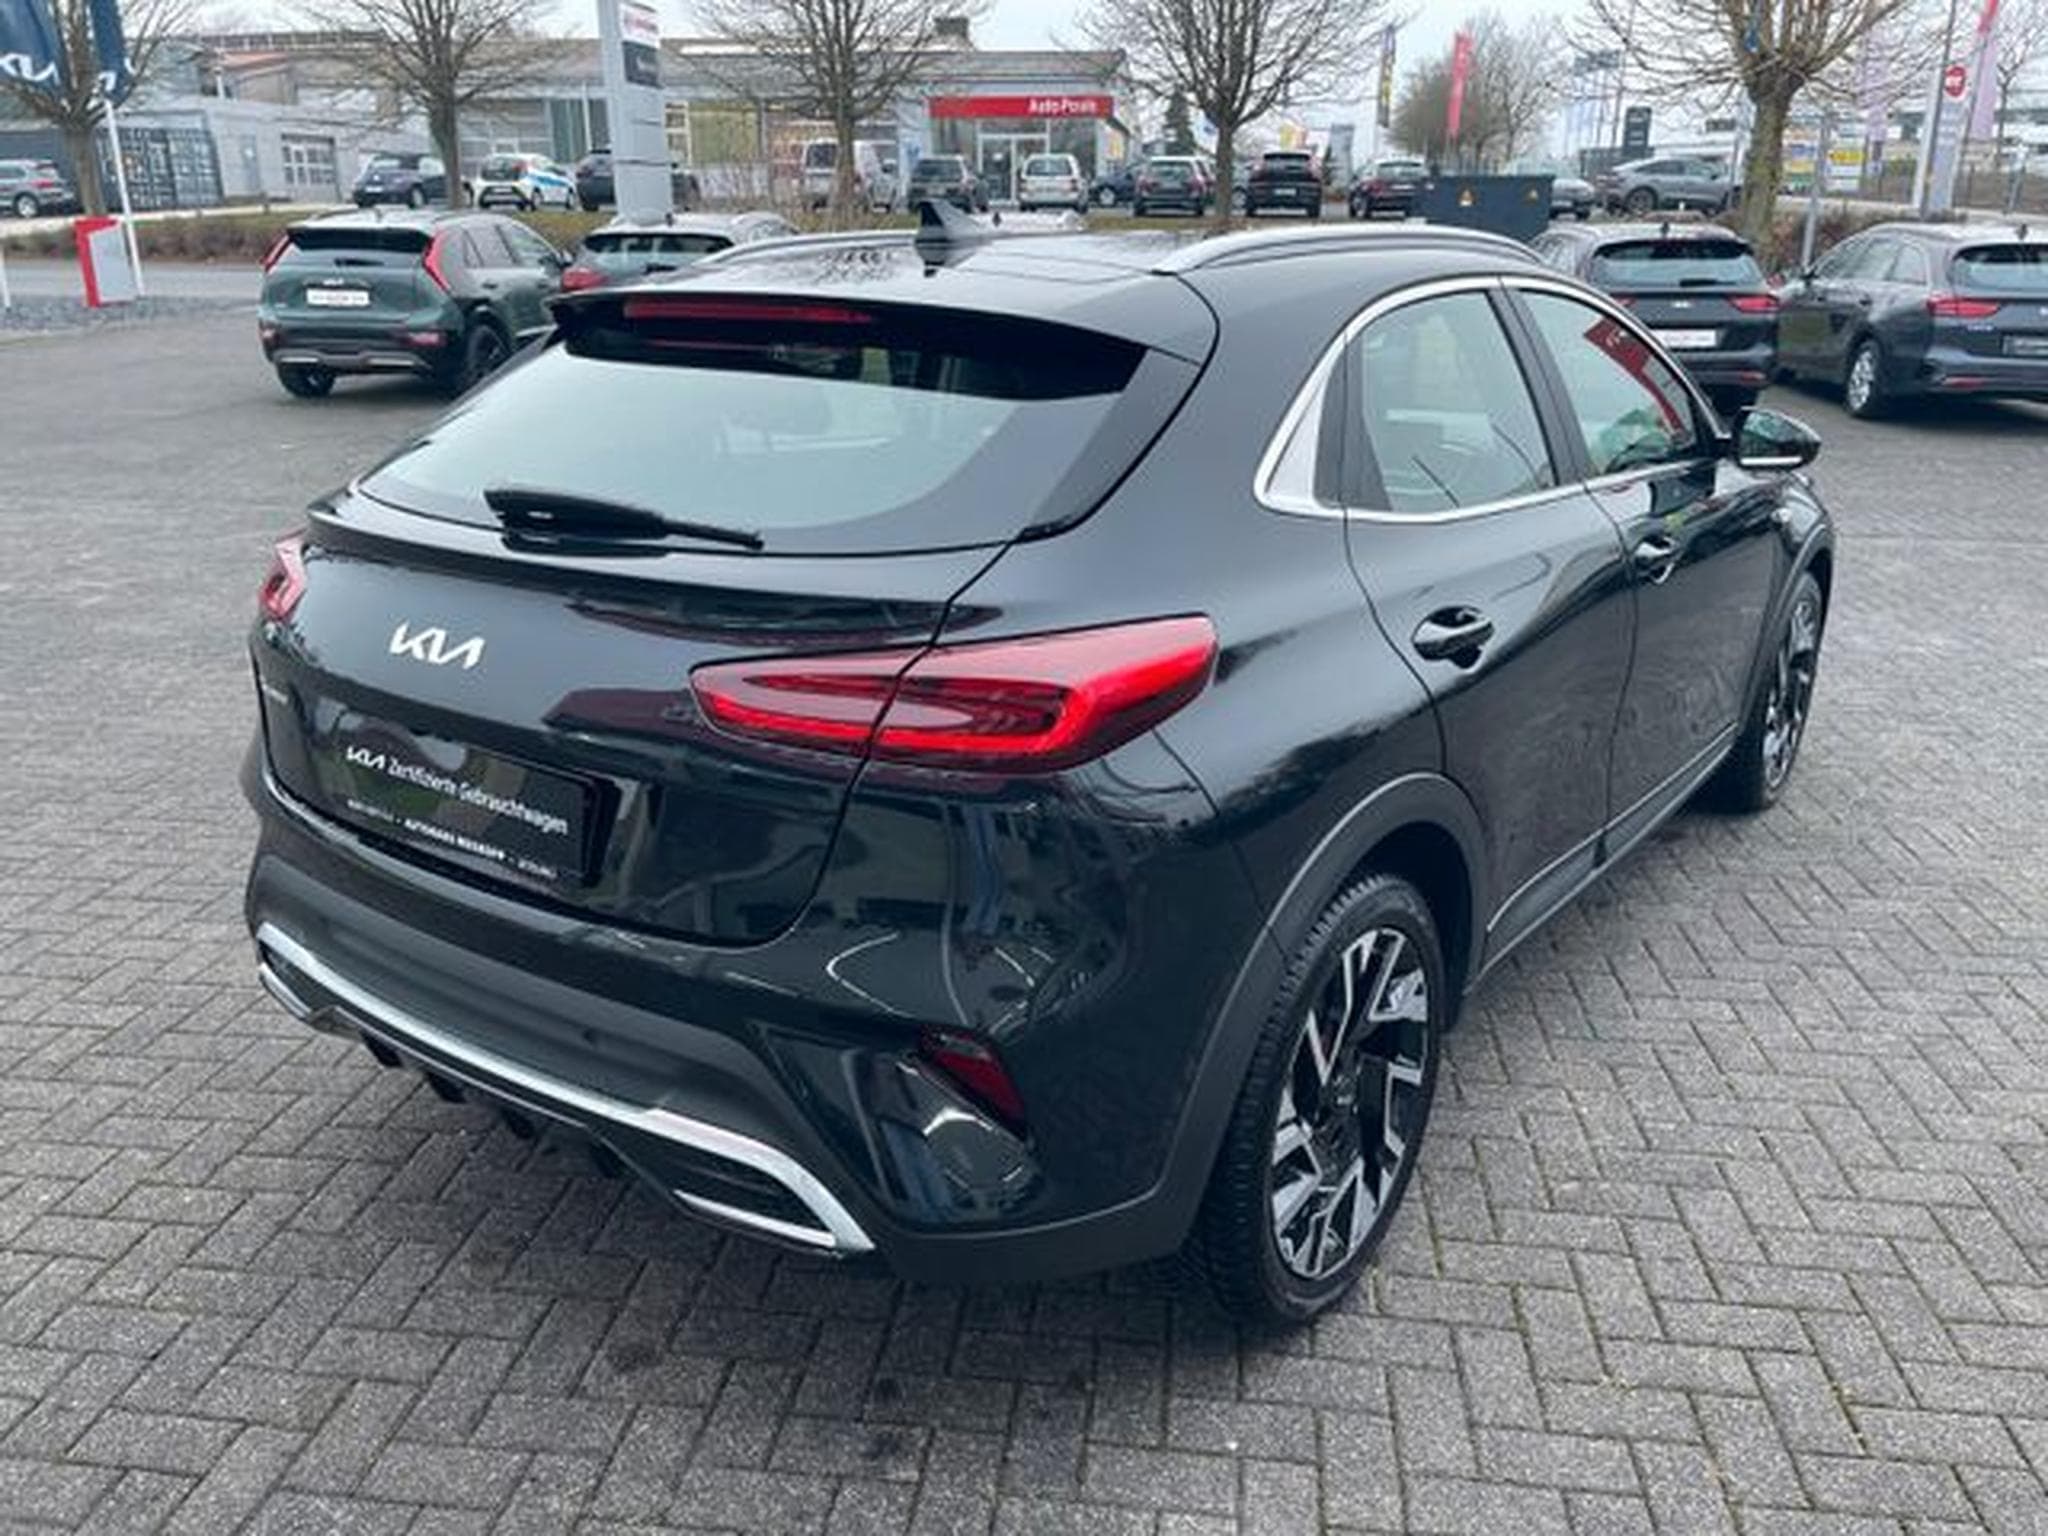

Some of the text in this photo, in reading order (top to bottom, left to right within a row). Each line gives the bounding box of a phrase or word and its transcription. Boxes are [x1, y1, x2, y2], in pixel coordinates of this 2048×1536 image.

[1028, 98, 1059, 114] Auto
[389, 619, 486, 670] KIA
[346, 746, 386, 769] KIA
